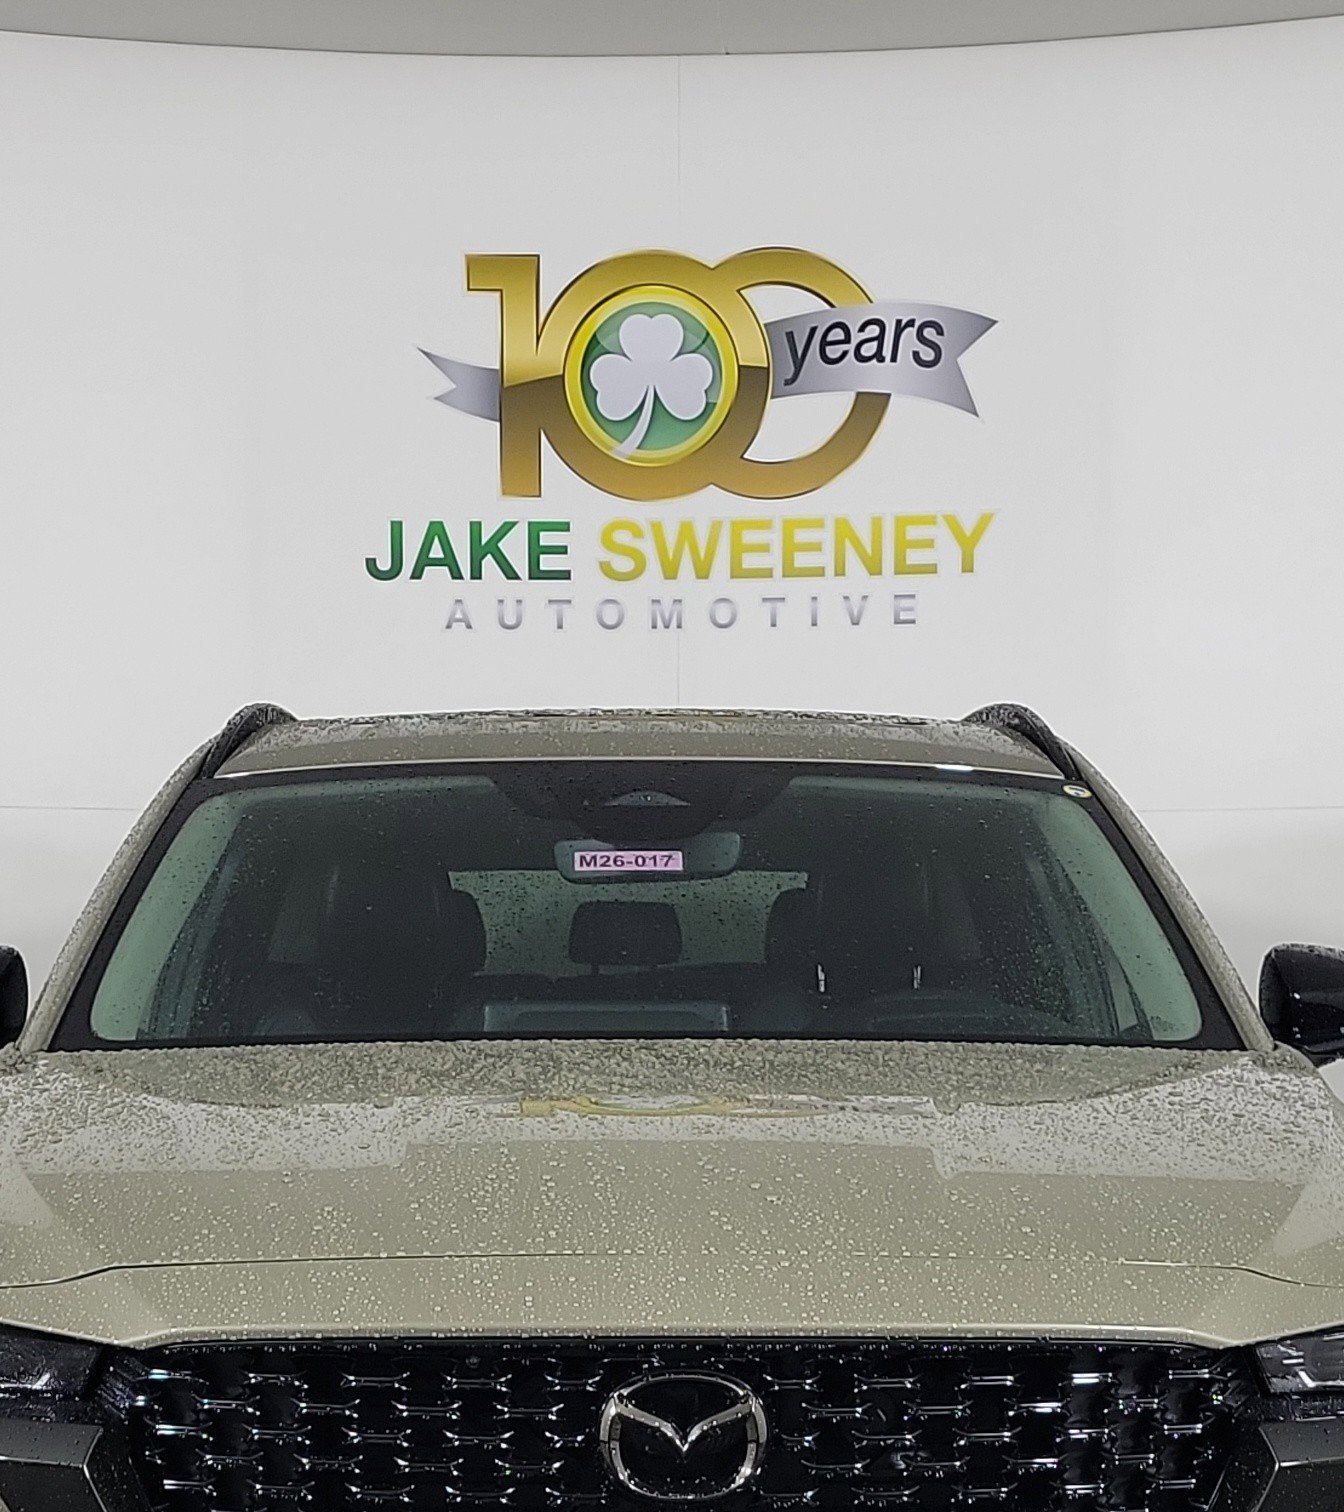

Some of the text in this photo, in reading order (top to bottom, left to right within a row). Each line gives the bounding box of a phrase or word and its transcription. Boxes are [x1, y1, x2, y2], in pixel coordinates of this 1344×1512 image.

[465, 247, 945, 502] 100 years
[365, 512, 995, 581] JAKE SWEENEY
[444, 593, 917, 630] AUTOMOTIVE
[578, 854, 674, 868] M26-017
